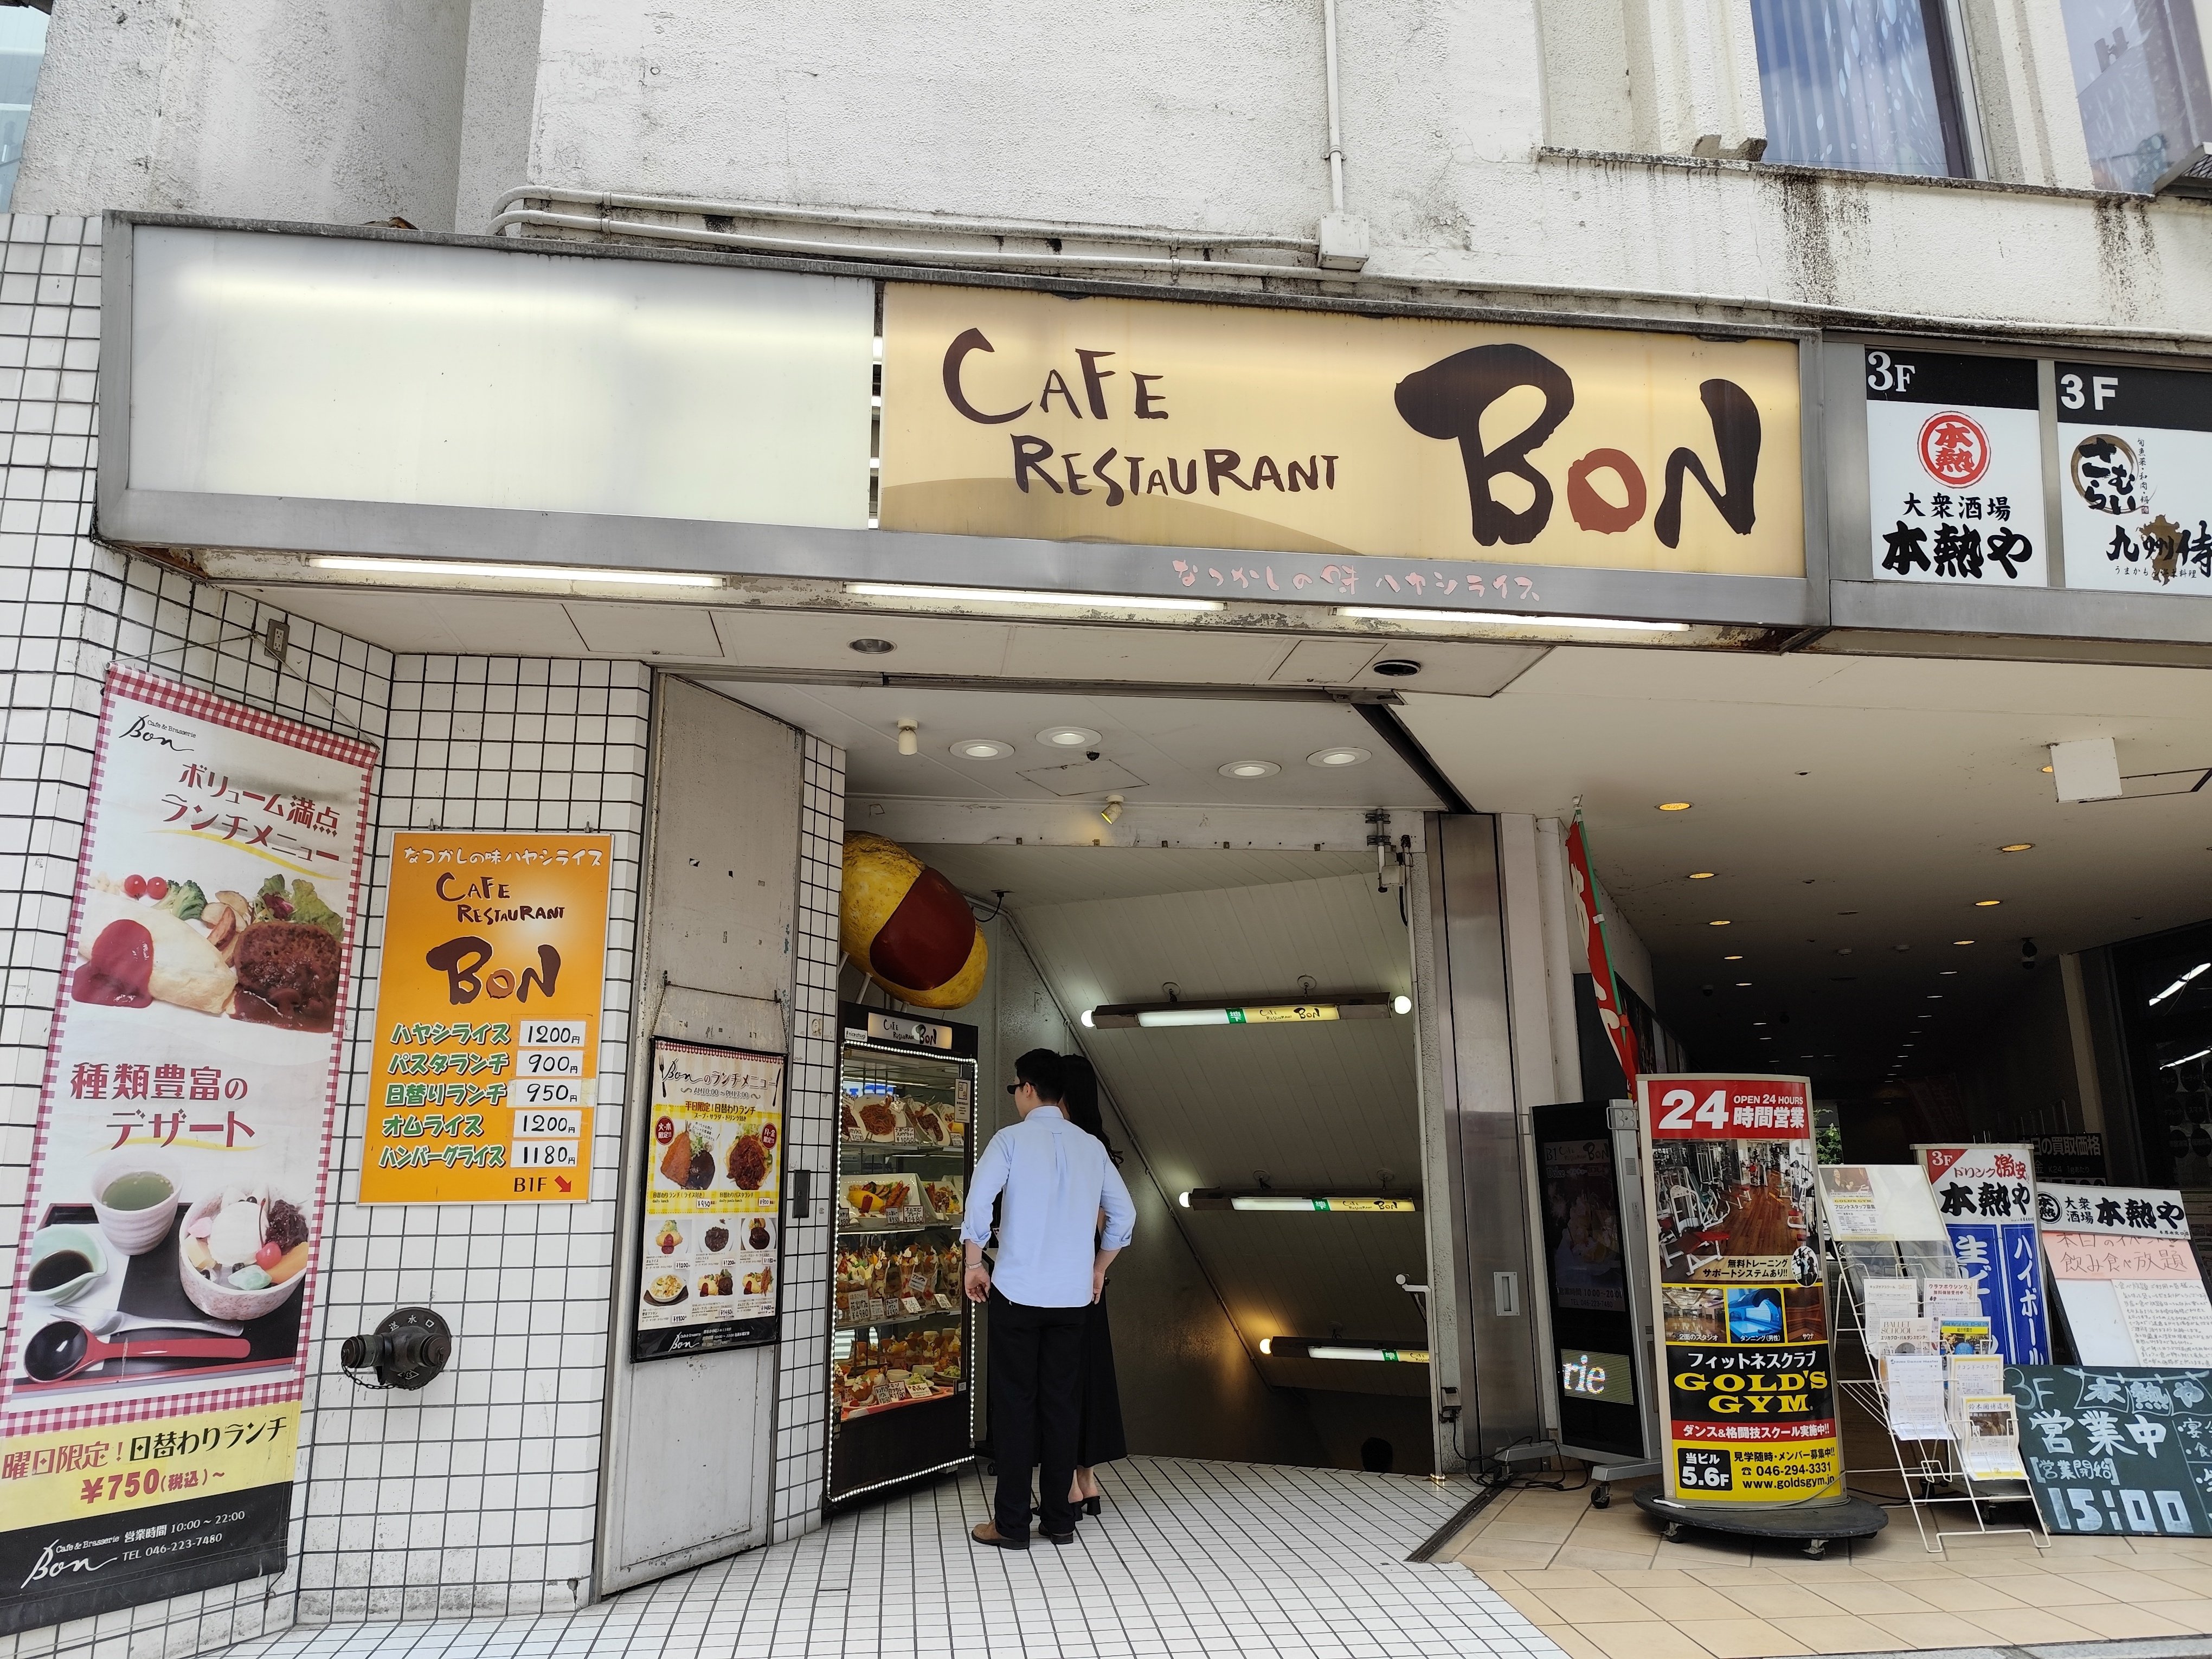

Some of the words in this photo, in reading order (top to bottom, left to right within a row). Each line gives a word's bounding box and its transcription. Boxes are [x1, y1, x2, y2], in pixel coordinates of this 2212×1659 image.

[943, 328, 1169, 425] CAFE
[1868, 351, 1915, 392] 3F
[2061, 374, 2119, 410] 3F
[1394, 343, 1761, 549] BON
[1934, 423, 1975, 473] 本熱
[1011, 434, 1339, 506] RESTAURANT
[1902, 492, 2011, 522] 大衆酒場
[1881, 521, 2033, 580] 本熱や
[2106, 520, 2212, 578] 九州侍
[118, 715, 194, 751] Bon
[147, 720, 160, 728] Cafe
[168, 726, 196, 738] Brasserie
[178, 763, 340, 838] ボリューム満点
[162, 794, 340, 862] ランチメニュー
[436, 872, 511, 902] CAFE
[457, 904, 565, 925] RESTAURANT
[426, 935, 561, 1005] BON
[883, 1019, 898, 1031] CAFE
[1230, 1011, 1242, 1022] 地下
[1294, 1007, 1320, 1019] BON
[390, 1022, 511, 1045] ハヤシライス
[528, 1025, 581, 1044] 1200円
[916, 1024, 937, 1045] BON
[388, 1052, 510, 1075] パスタランチ
[529, 1054, 578, 1073] 900円
[662, 1058, 703, 1082] Bon
[70, 1062, 248, 1101] 種類豊富の
[385, 1082, 507, 1107] 日替りランチ
[526, 1083, 577, 1102] 950円
[1733, 1095, 1760, 1105] OPEN
[1763, 1094, 1776, 1104] 24
[1778, 1095, 1804, 1105] HOURS
[1658, 1089, 1729, 1129] 24
[1733, 1107, 1805, 1129] 時間営業
[107, 1108, 255, 1150] デザート
[382, 1113, 484, 1138] オムライス
[524, 1115, 576, 1133] 1200円
[378, 1144, 506, 1168] ハンバーグライス
[524, 1145, 575, 1165] 1180円
[1932, 1150, 1953, 1166] 3F
[513, 1177, 548, 1192] B1F
[1373, 1200, 1398, 1210] BON
[1939, 1182, 2030, 1217] 本熱や
[2095, 1197, 2184, 1230] 本熱や
[1727, 1259, 1789, 1269] 無料トレーニング
[2060, 1249, 2188, 1273] 飲み食べ放題
[389, 1315, 435, 1332] 送水口
[1688, 1351, 1816, 1369] フィットネスクラブ
[1674, 1370, 1828, 1392] GOLD'S
[2003, 1367, 2054, 1410] 3F
[1708, 1394, 1810, 1413] GYM
[1683, 1423, 1830, 1439] ダンス&格闘技スクール実施中!!
[2029, 1409, 2167, 1458] 営業中
[1686, 1452, 1720, 1465] 当ビル
[1756, 1462, 1831, 1476] 046-294-3331
[1682, 1466, 1729, 1487] 5.6F
[1742, 1476, 1835, 1489] www.goldsgym.jp
[2047, 1488, 2194, 1533] 15:00
[124, 1525, 168, 1543] 営業時間
[171, 1519, 201, 1534] 10:00
[215, 1511, 245, 1525] 22:00
[56, 1544, 73, 1554] Cafe
[74, 1542, 82, 1551] &
[83, 1535, 119, 1550] Brasserie
[123, 1551, 142, 1561] TEL
[145, 1533, 223, 1557] 046-223-7480
[20, 1539, 117, 1589] Bon
